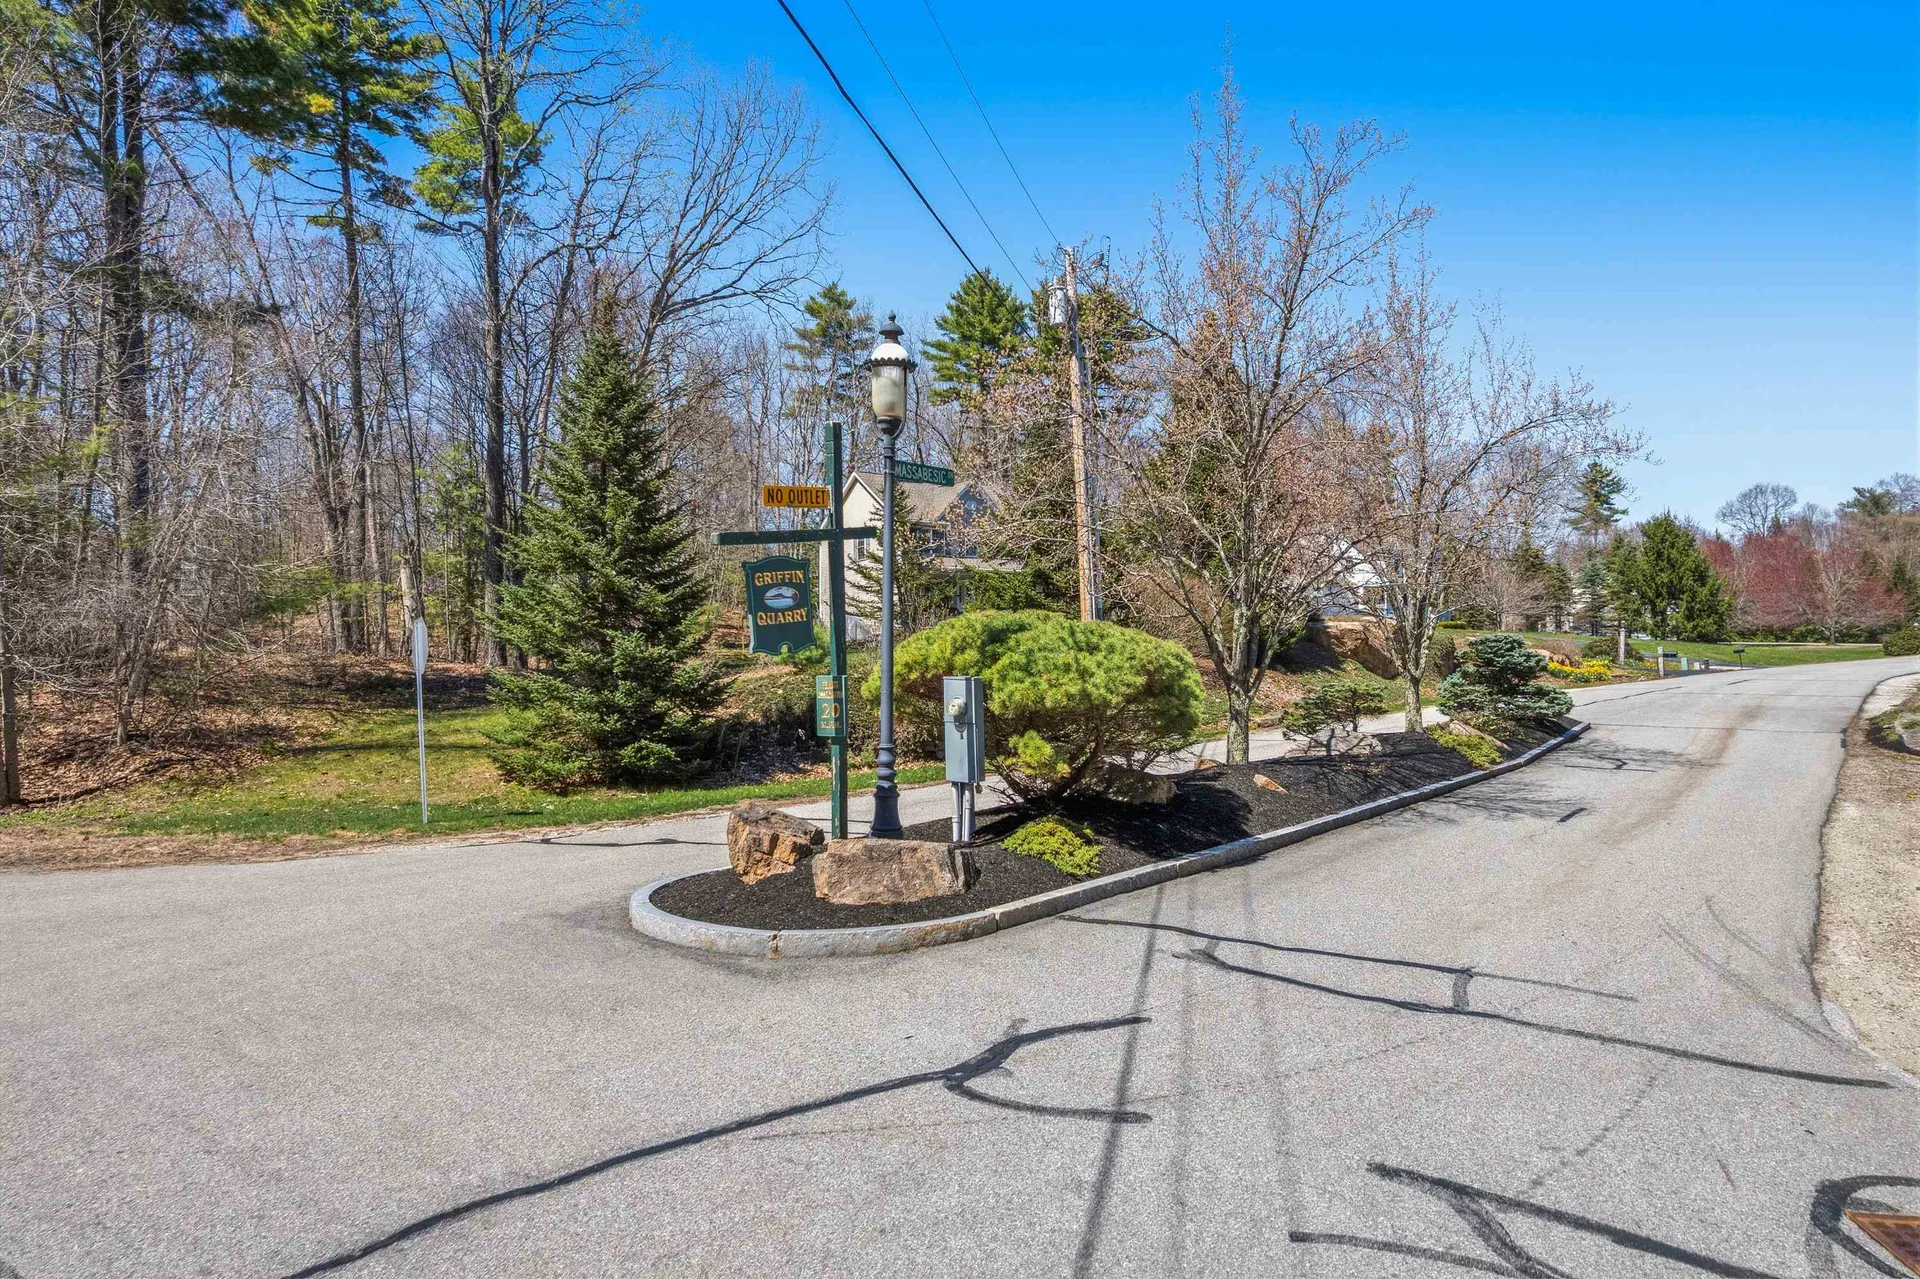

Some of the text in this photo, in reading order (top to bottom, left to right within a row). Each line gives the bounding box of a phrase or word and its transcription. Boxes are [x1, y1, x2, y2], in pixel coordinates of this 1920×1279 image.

[895, 463, 947, 484] MASSABESIC
[767, 488, 826, 505] NO OUTLET
[754, 570, 805, 586] GRIFFIN
[756, 607, 808, 626] QUARRY
[821, 703, 840, 718] 20
